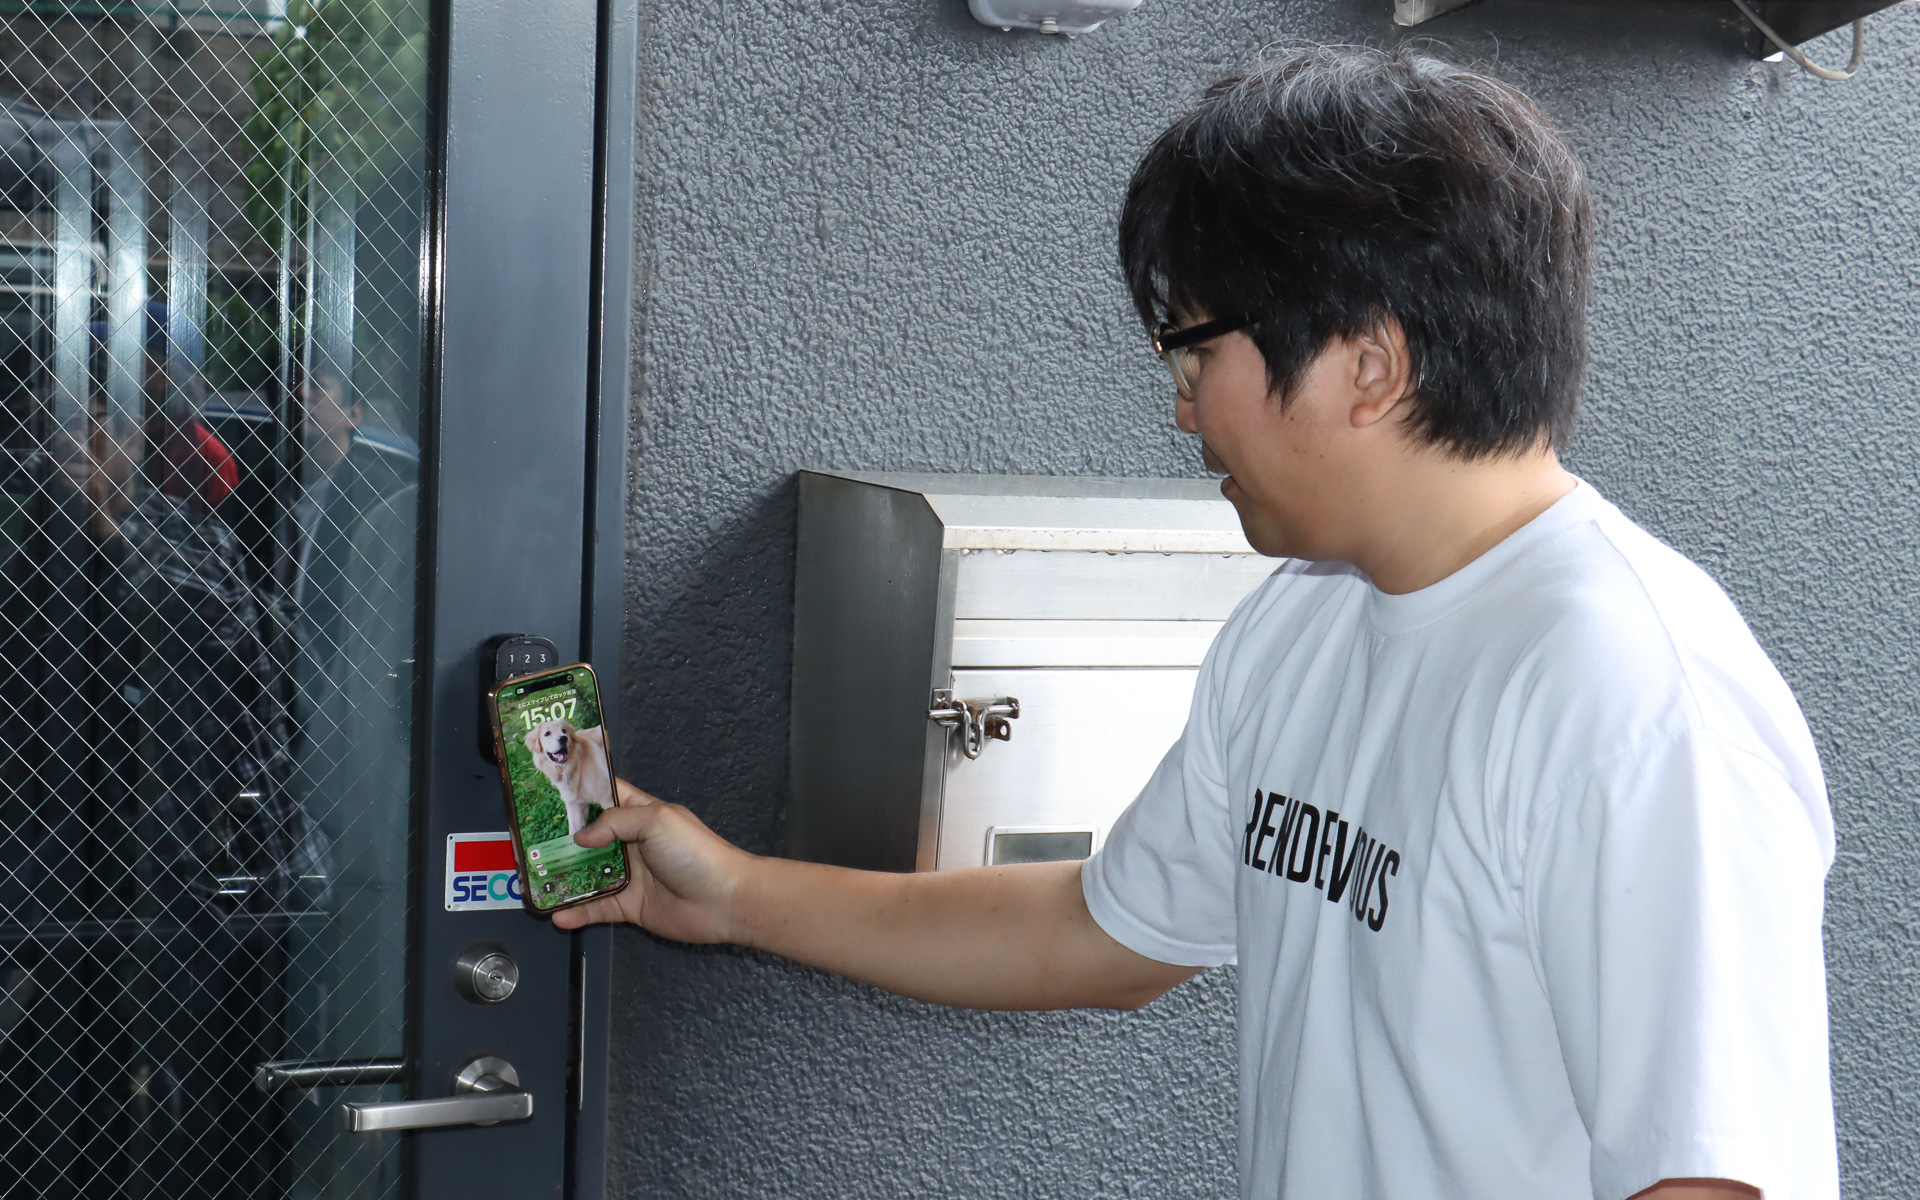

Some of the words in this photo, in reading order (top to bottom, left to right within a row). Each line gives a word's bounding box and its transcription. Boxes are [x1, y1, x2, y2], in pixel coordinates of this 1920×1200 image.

[509, 654, 514, 663] 1
[524, 654, 531, 663] 2
[540, 653, 546, 663] 3
[520, 697, 577, 730] 15:07
